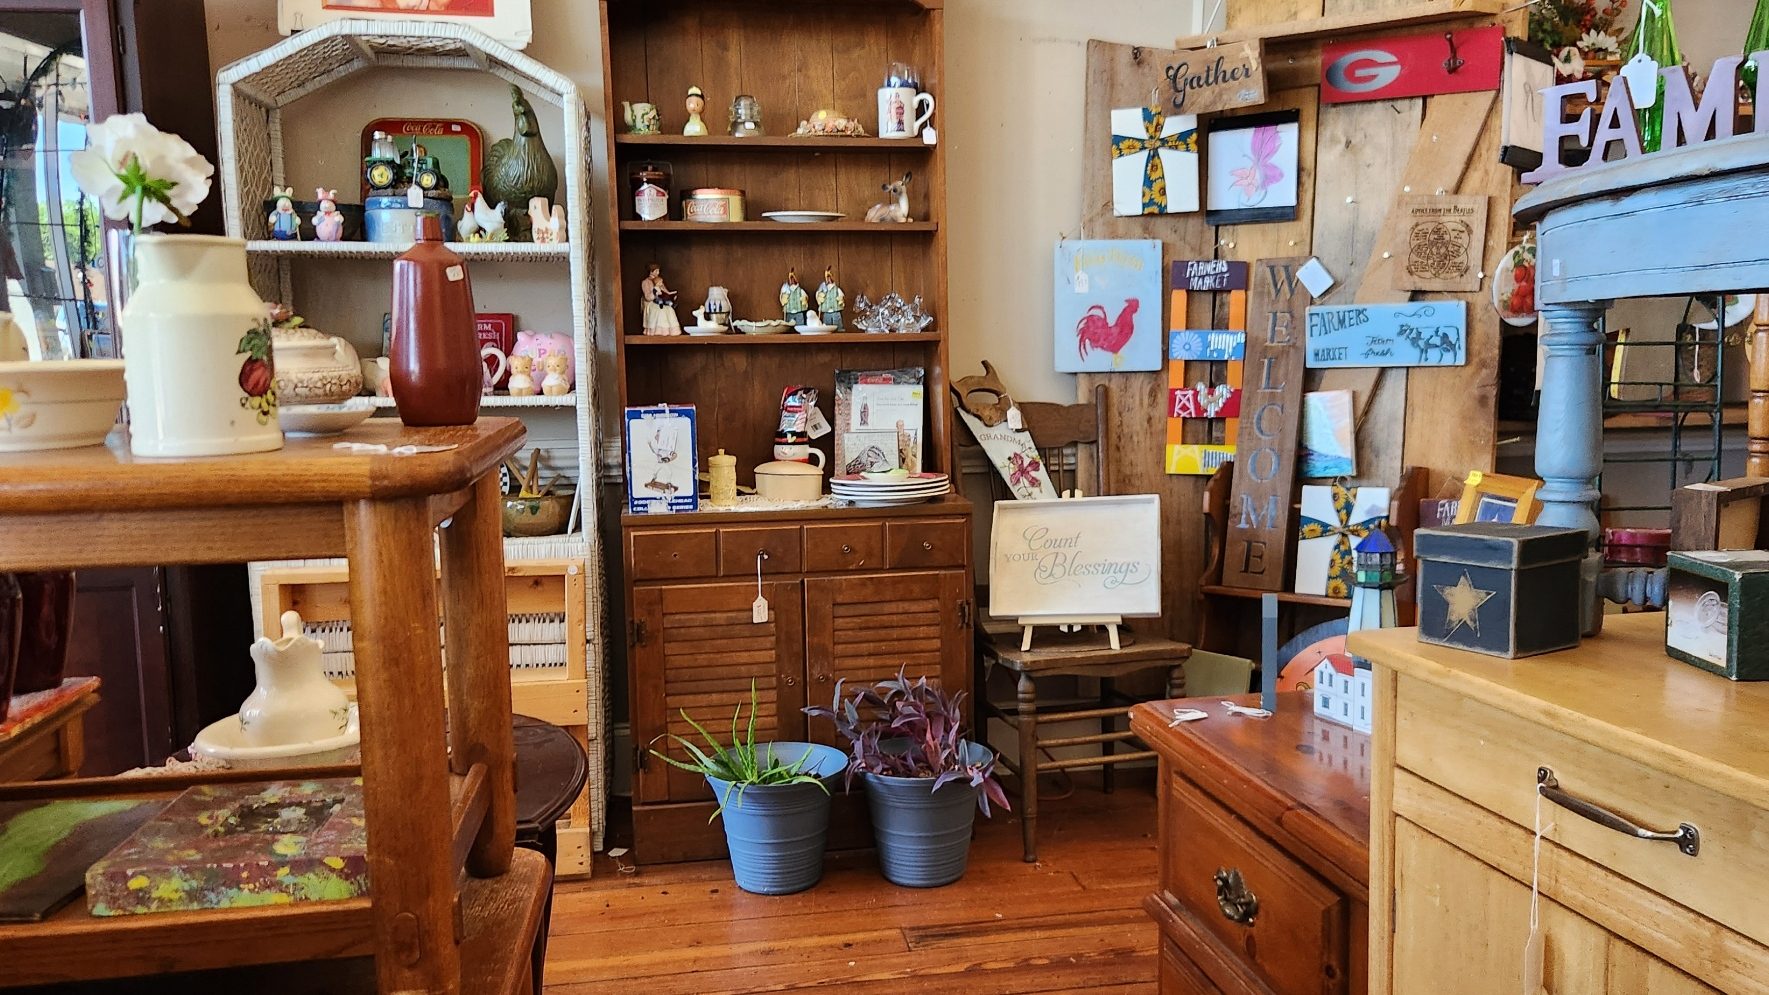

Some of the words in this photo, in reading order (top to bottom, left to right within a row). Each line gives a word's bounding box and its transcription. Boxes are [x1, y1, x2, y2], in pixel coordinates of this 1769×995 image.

[1165, 56, 1251, 109] Gather
[1326, 49, 1401, 93] G
[1185, 259, 1229, 279] FARMERS
[1189, 273, 1230, 291] MARKET
[1308, 308, 1370, 338] FARMERS
[1312, 346, 1349, 362] MARKET
[1235, 263, 1299, 576] WELCOME
[979, 433, 1027, 452] GRANDMA
[1023, 525, 1082, 551] Count
[1004, 553, 1038, 563] YOUR
[1034, 550, 1151, 589] Blessings
